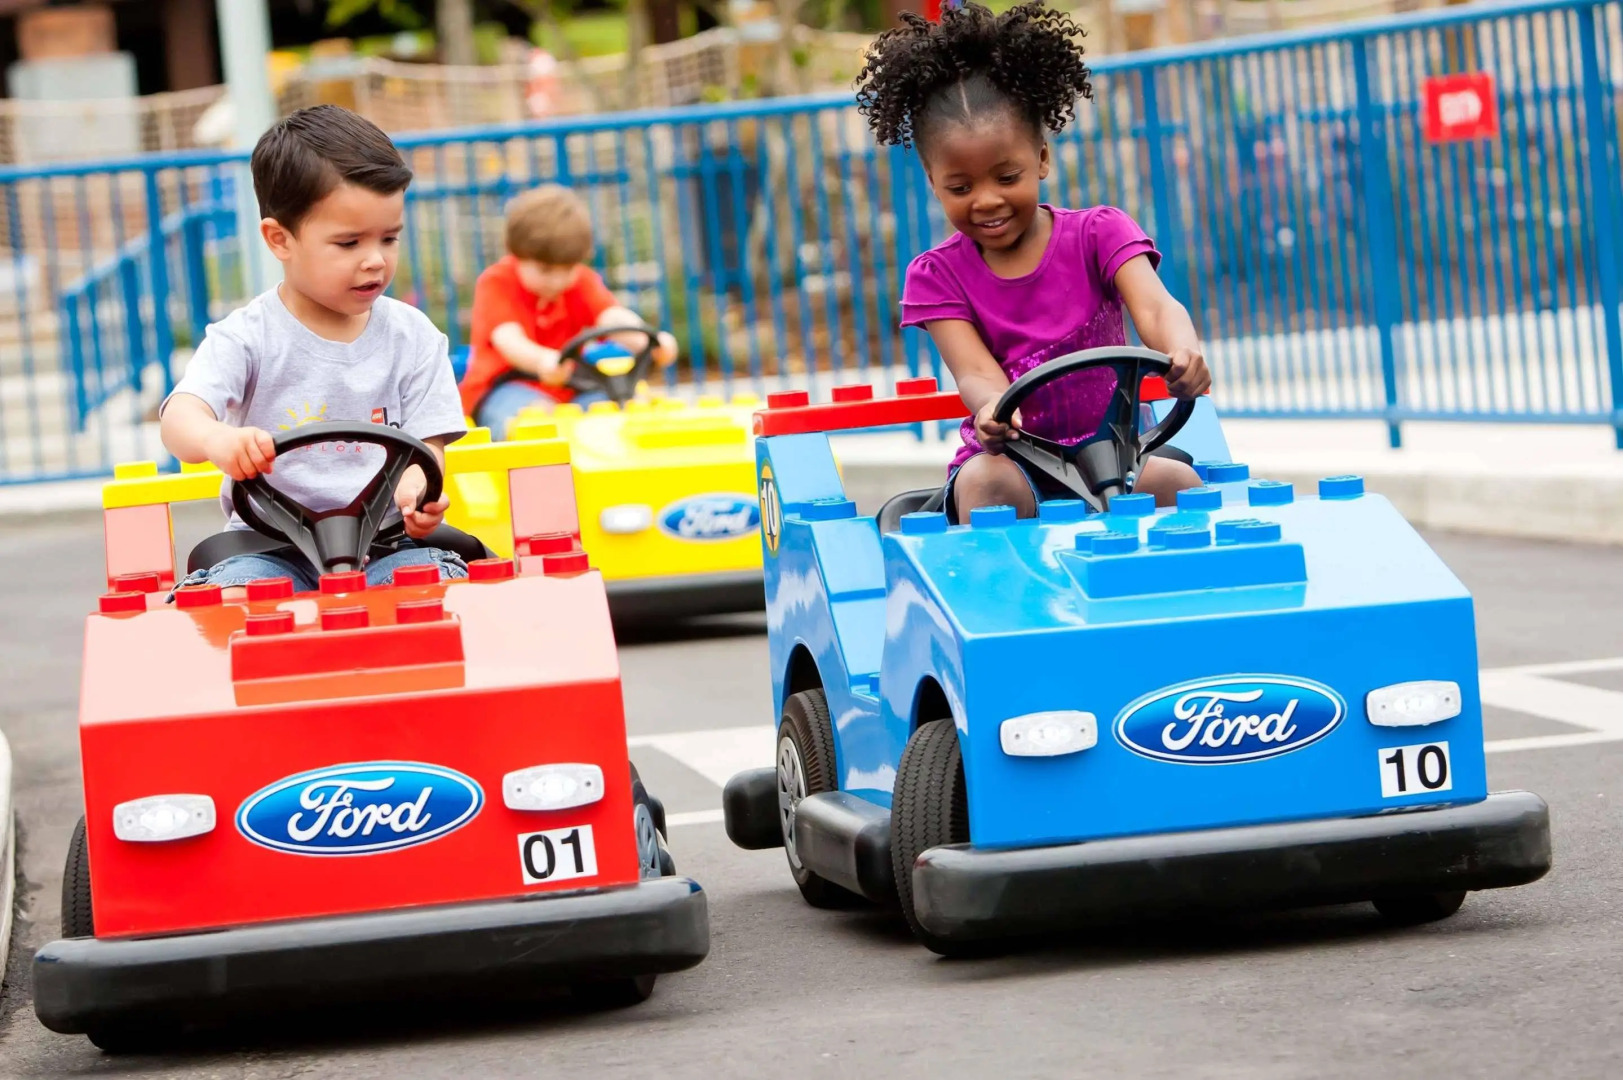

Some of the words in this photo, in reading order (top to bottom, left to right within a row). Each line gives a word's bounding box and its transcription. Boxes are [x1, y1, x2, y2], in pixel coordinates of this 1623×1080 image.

[304, 444, 384, 453] FLOR
[761, 481, 777, 535] 10
[1161, 689, 1300, 750] Ford
[1385, 744, 1448, 792] 10
[287, 776, 432, 842] Ford
[523, 828, 585, 880] 01
